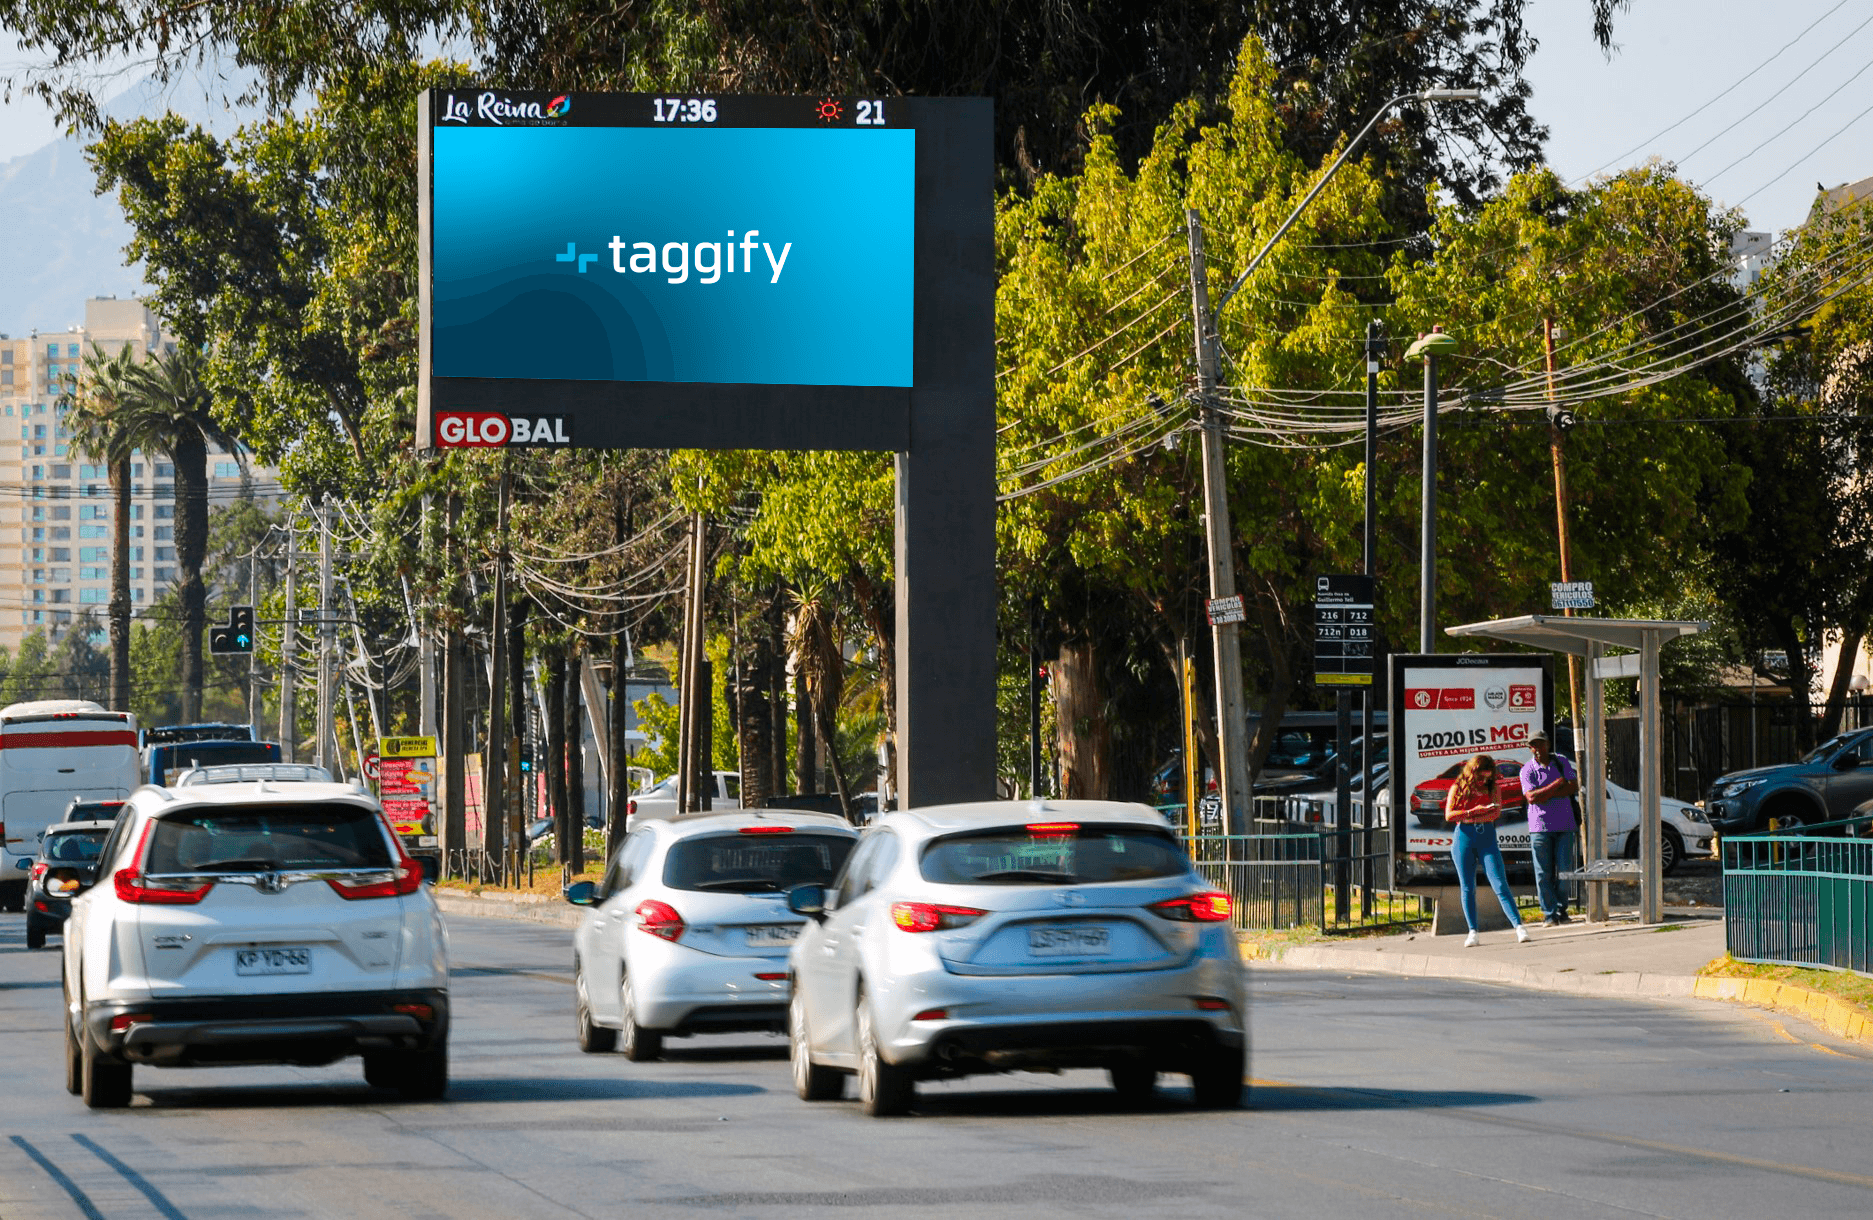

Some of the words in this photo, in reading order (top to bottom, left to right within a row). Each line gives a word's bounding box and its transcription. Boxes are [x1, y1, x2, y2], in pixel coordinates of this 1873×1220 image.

[442, 94, 473, 124] La
[477, 92, 548, 125] Reina
[653, 98, 717, 122] 17:36
[856, 100, 885, 125] 21
[608, 230, 792, 284] taggify
[440, 416, 570, 443] GLOBAL
[1551, 581, 1593, 592] COMPRO
[1552, 591, 1593, 599] VEHICULOS
[1321, 612, 1339, 620] 216
[1350, 612, 1367, 620] 712
[1318, 628, 1341, 636] 712n
[1512, 691, 1524, 706] 6
[1469, 728, 1487, 745] IS
[1490, 723, 1529, 742] MG!
[1480, 744, 1502, 752] MARCA
